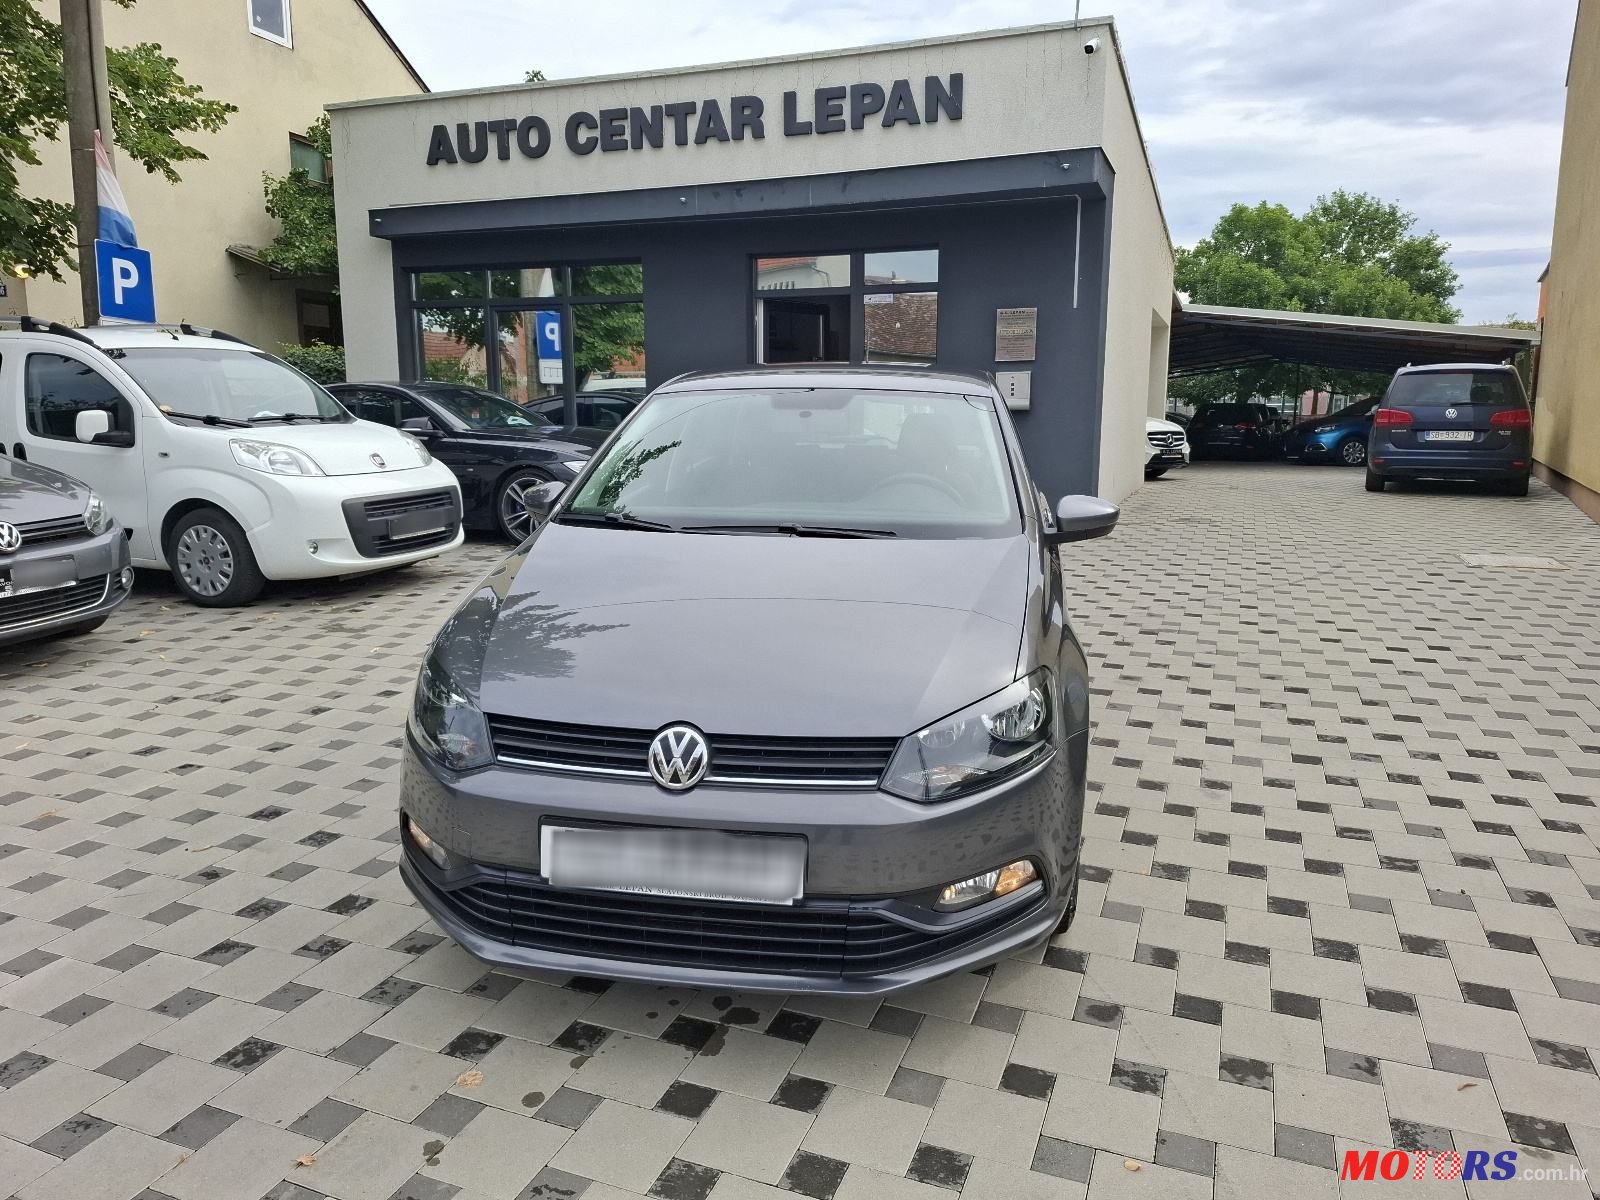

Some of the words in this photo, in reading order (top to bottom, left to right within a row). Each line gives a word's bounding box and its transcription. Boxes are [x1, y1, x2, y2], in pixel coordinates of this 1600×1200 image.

[426, 115, 552, 166] AUTO
[564, 95, 766, 155] CENTAR
[783, 72, 964, 137] LEPAN
[112, 257, 139, 305] P
[649, 727, 707, 789] VW
